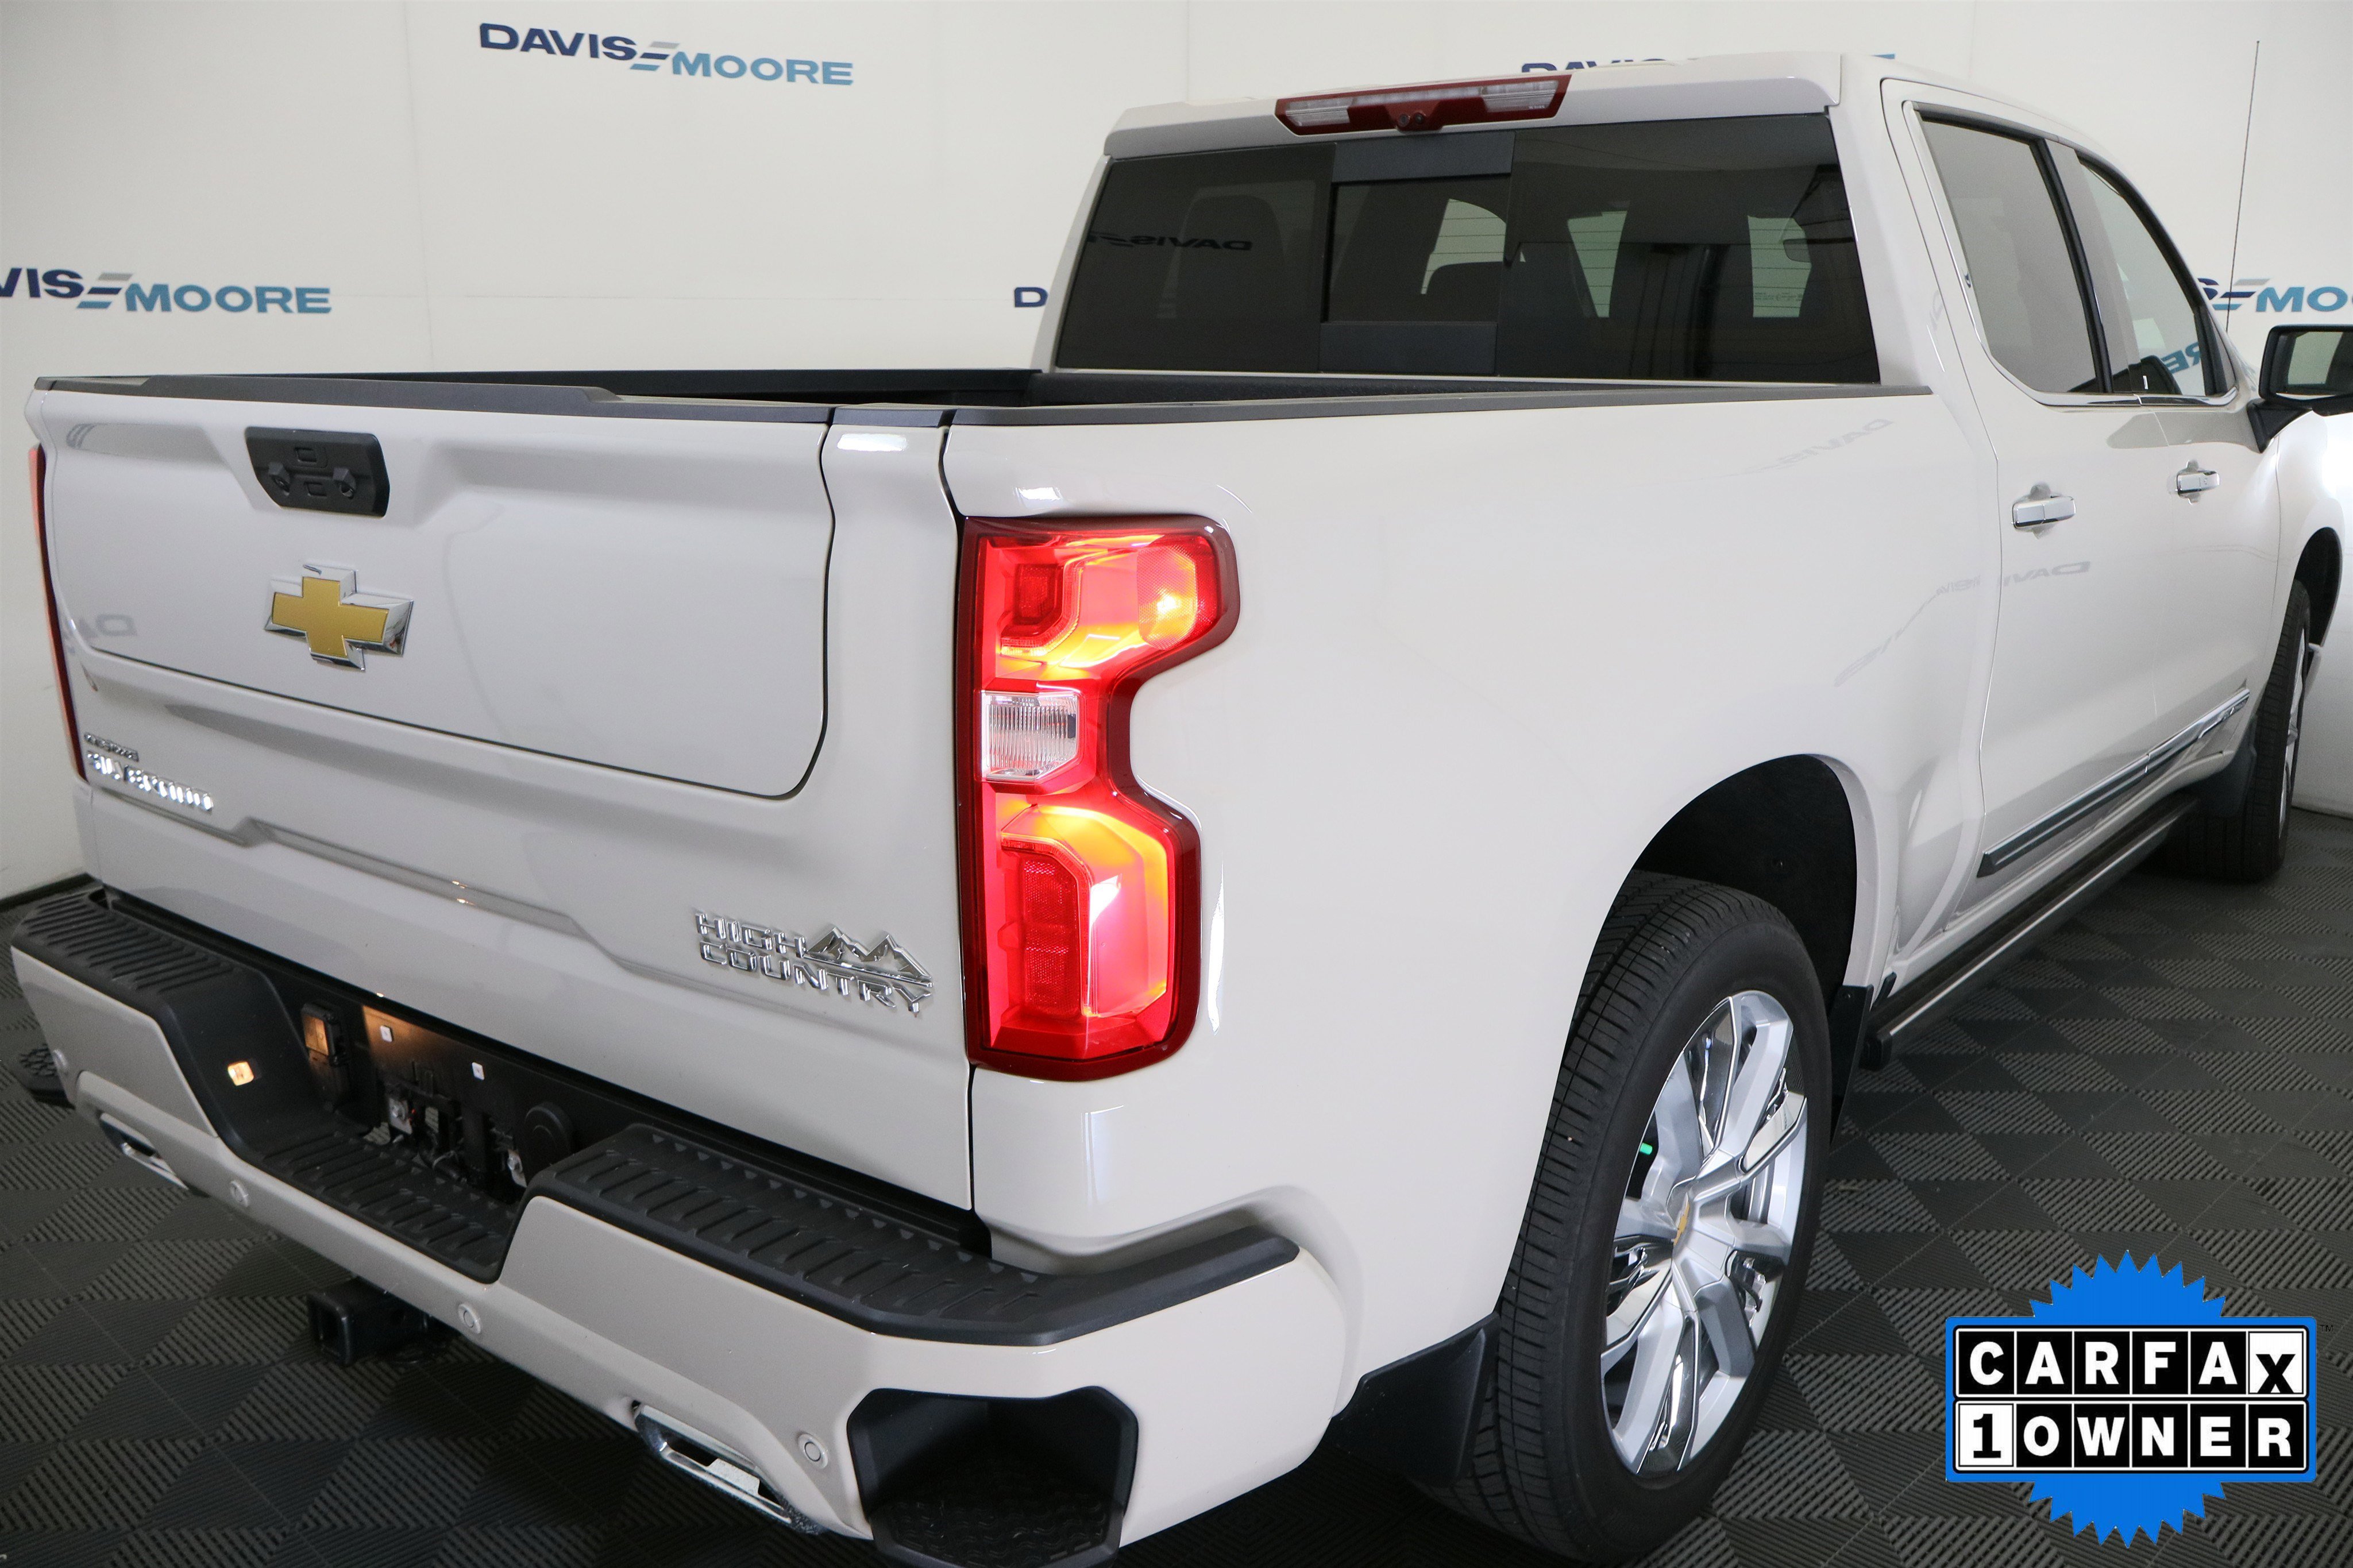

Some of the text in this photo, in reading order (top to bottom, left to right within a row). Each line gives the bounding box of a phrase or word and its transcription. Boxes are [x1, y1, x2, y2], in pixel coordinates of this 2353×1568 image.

[480, 23, 854, 86] DAVIS MOORE
[125, 283, 332, 314] MOORE
[2255, 286, 2353, 312] MO
[695, 913, 806, 958] HIGH
[700, 940, 932, 1013] COUNTRY
